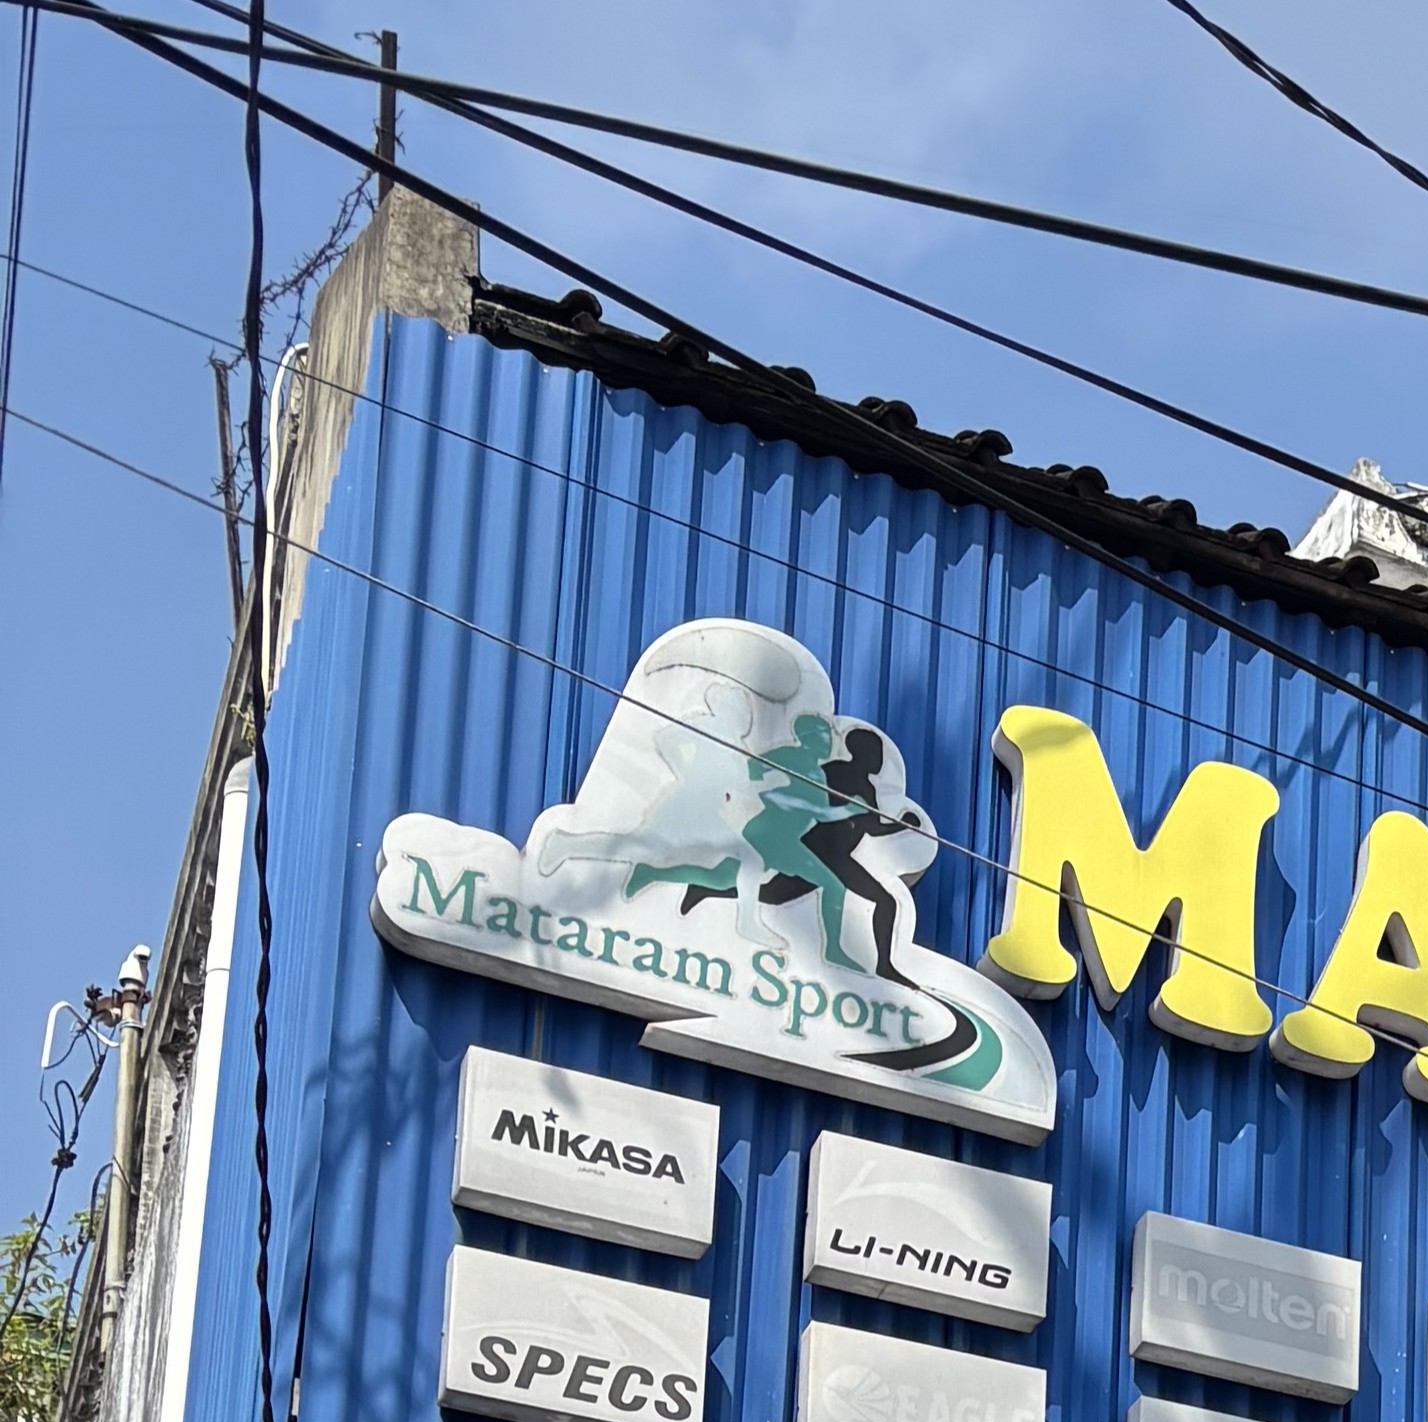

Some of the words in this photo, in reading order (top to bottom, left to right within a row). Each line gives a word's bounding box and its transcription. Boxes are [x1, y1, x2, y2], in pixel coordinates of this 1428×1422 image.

[401, 853, 733, 999] Mataram
[752, 950, 922, 1044] Sport
[491, 1107, 685, 1184] MIKASA
[830, 1228, 1011, 1288] LI-NING
[1159, 1261, 1347, 1341] molten
[470, 1335, 697, 1422] SPECS
